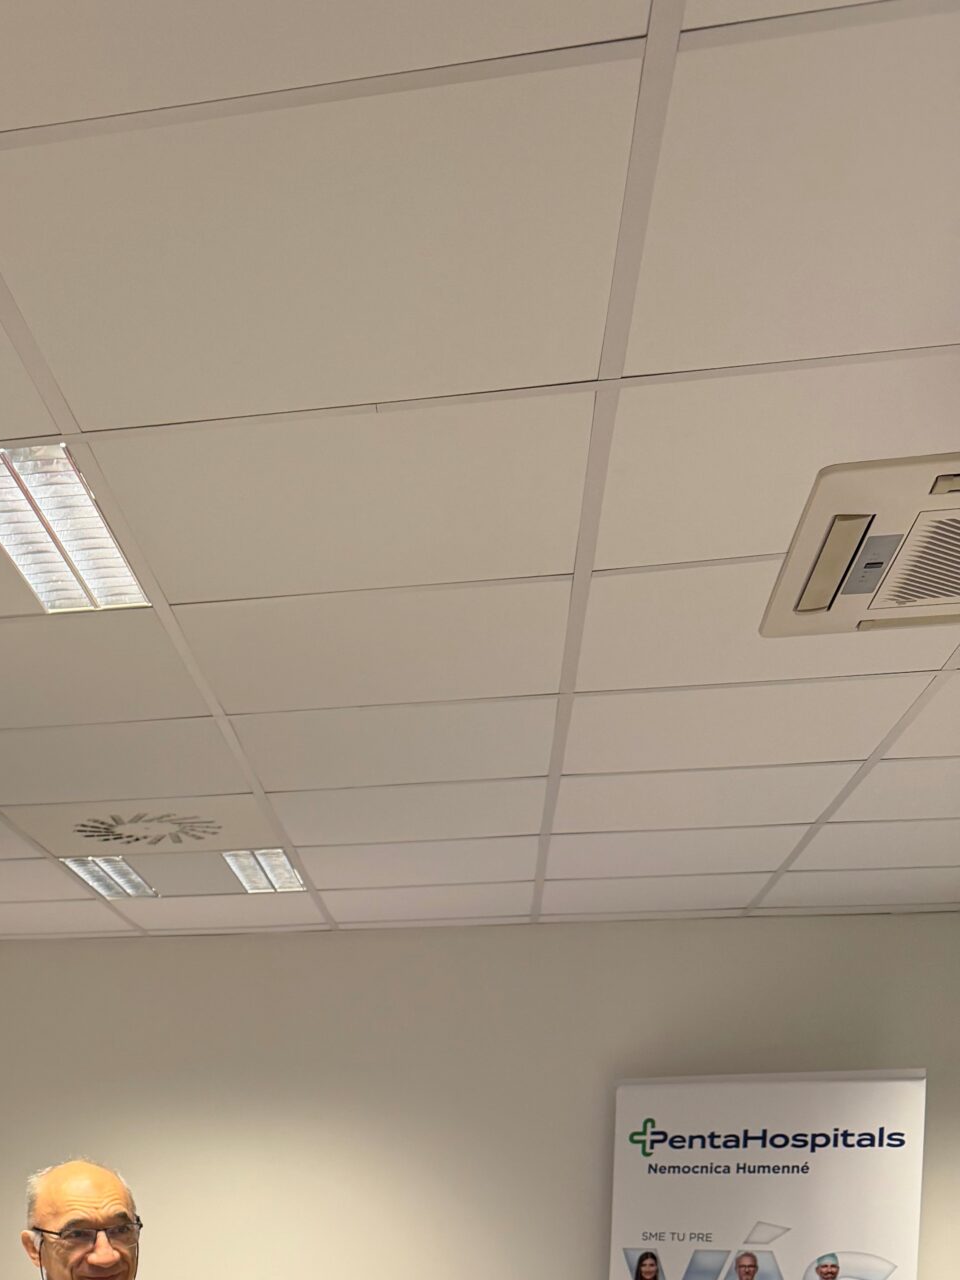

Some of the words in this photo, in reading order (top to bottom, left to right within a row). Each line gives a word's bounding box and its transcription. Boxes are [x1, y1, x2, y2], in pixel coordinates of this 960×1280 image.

[649, 1127, 906, 1153] PentaHospitals
[647, 1163, 731, 1175] Nemocnica
[736, 1161, 810, 1175] Humenné
[641, 1232, 666, 1242] SME
[670, 1232, 686, 1242] TU
[689, 1232, 713, 1242] PRE
